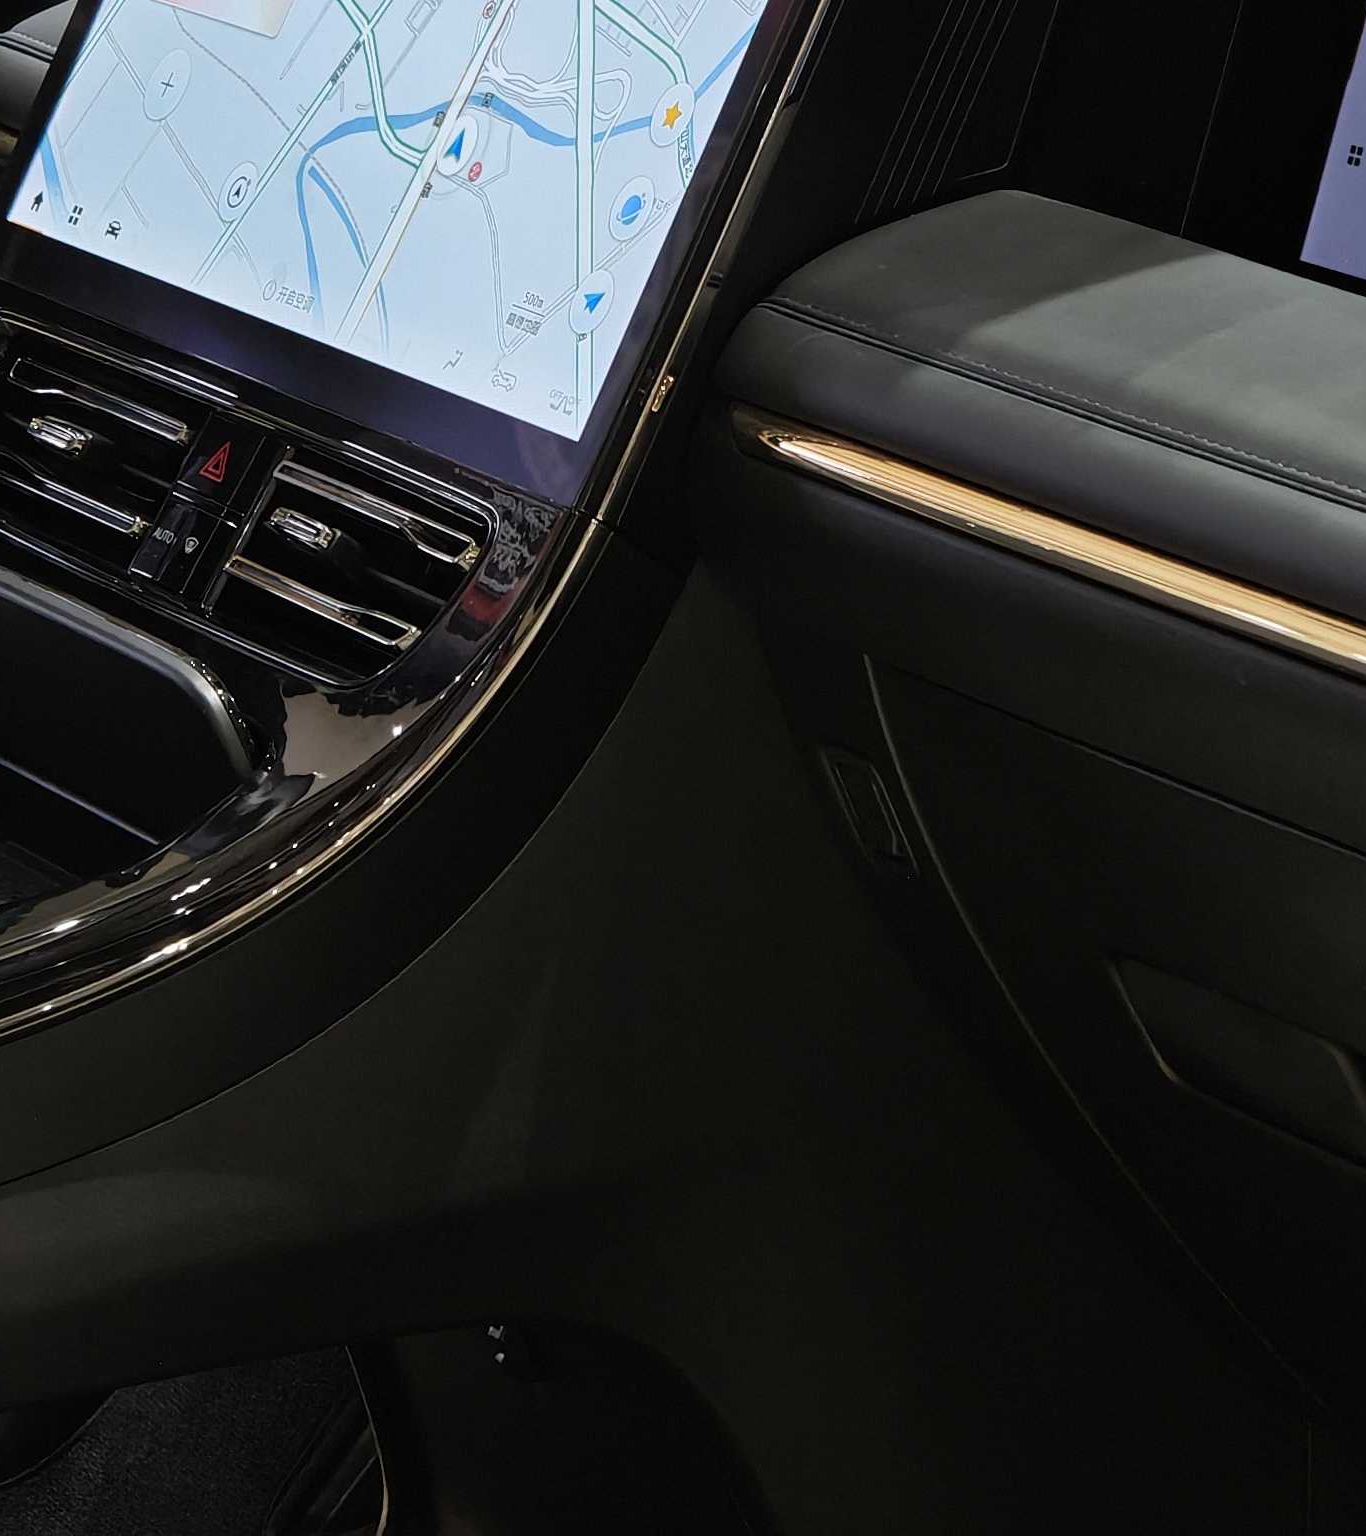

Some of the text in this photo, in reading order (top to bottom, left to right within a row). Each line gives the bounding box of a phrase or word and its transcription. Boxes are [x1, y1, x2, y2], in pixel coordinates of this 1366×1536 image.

[275, 285, 316, 314] 开启空调
[521, 291, 545, 309] 500m
[151, 526, 175, 545] AUTO
